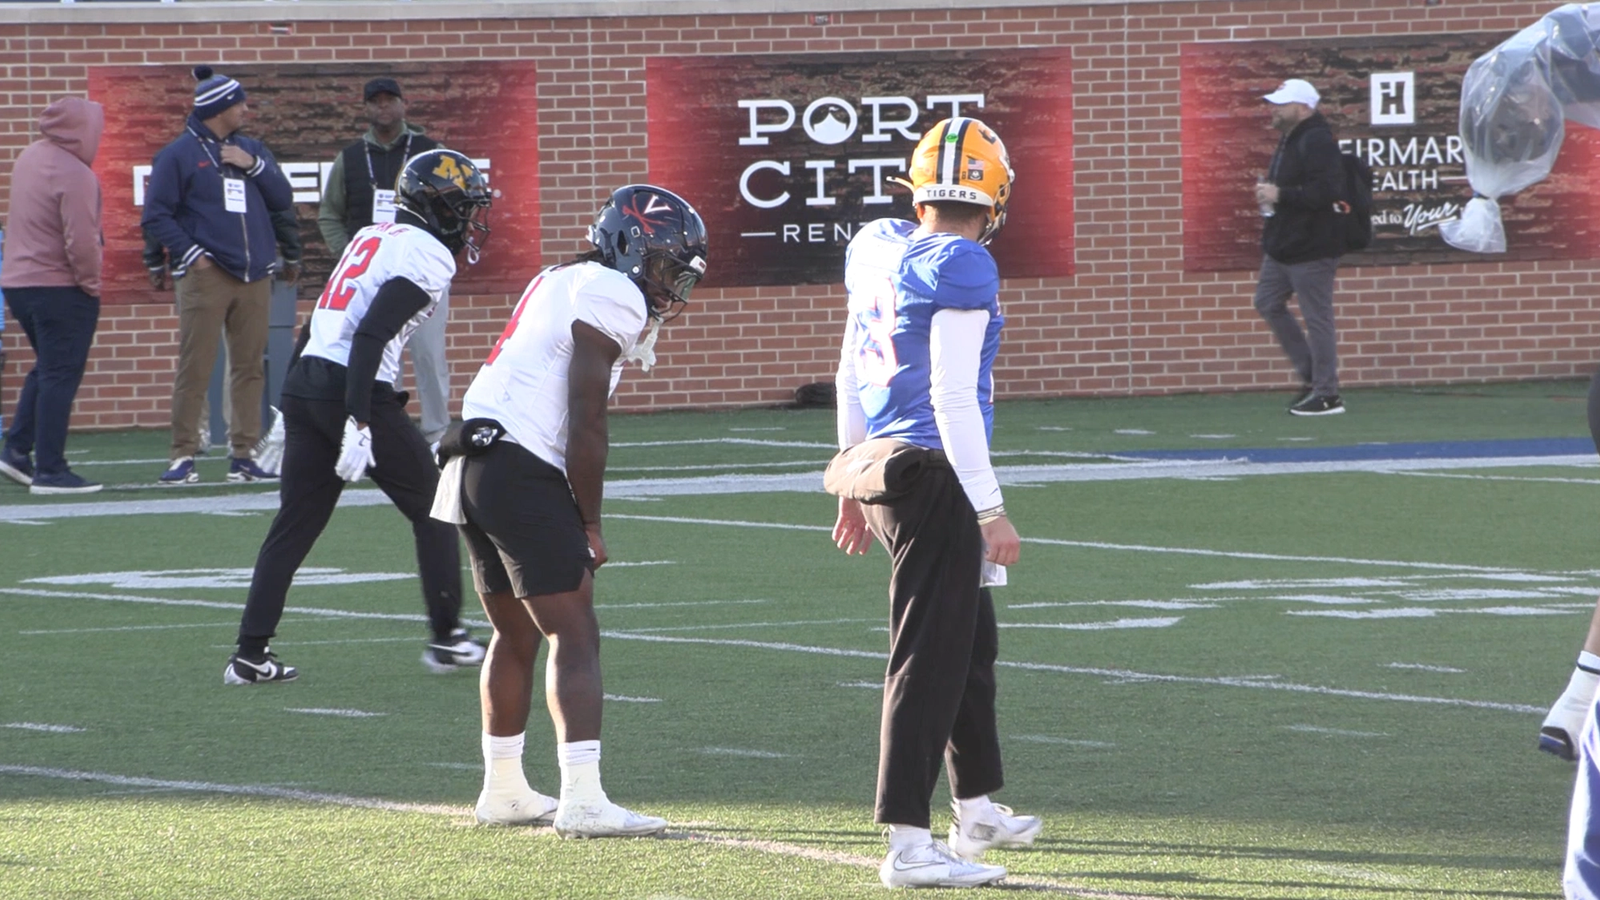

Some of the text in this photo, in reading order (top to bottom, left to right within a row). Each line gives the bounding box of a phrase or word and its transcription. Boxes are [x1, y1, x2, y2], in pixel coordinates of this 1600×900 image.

[738, 94, 985, 146] PORT
[739, 157, 906, 208] CIT
[926, 189, 977, 200] TIGERS
[783, 223, 869, 243] REN
[1371, 202, 1459, 236] ed to Your
[318, 235, 383, 312] 12
